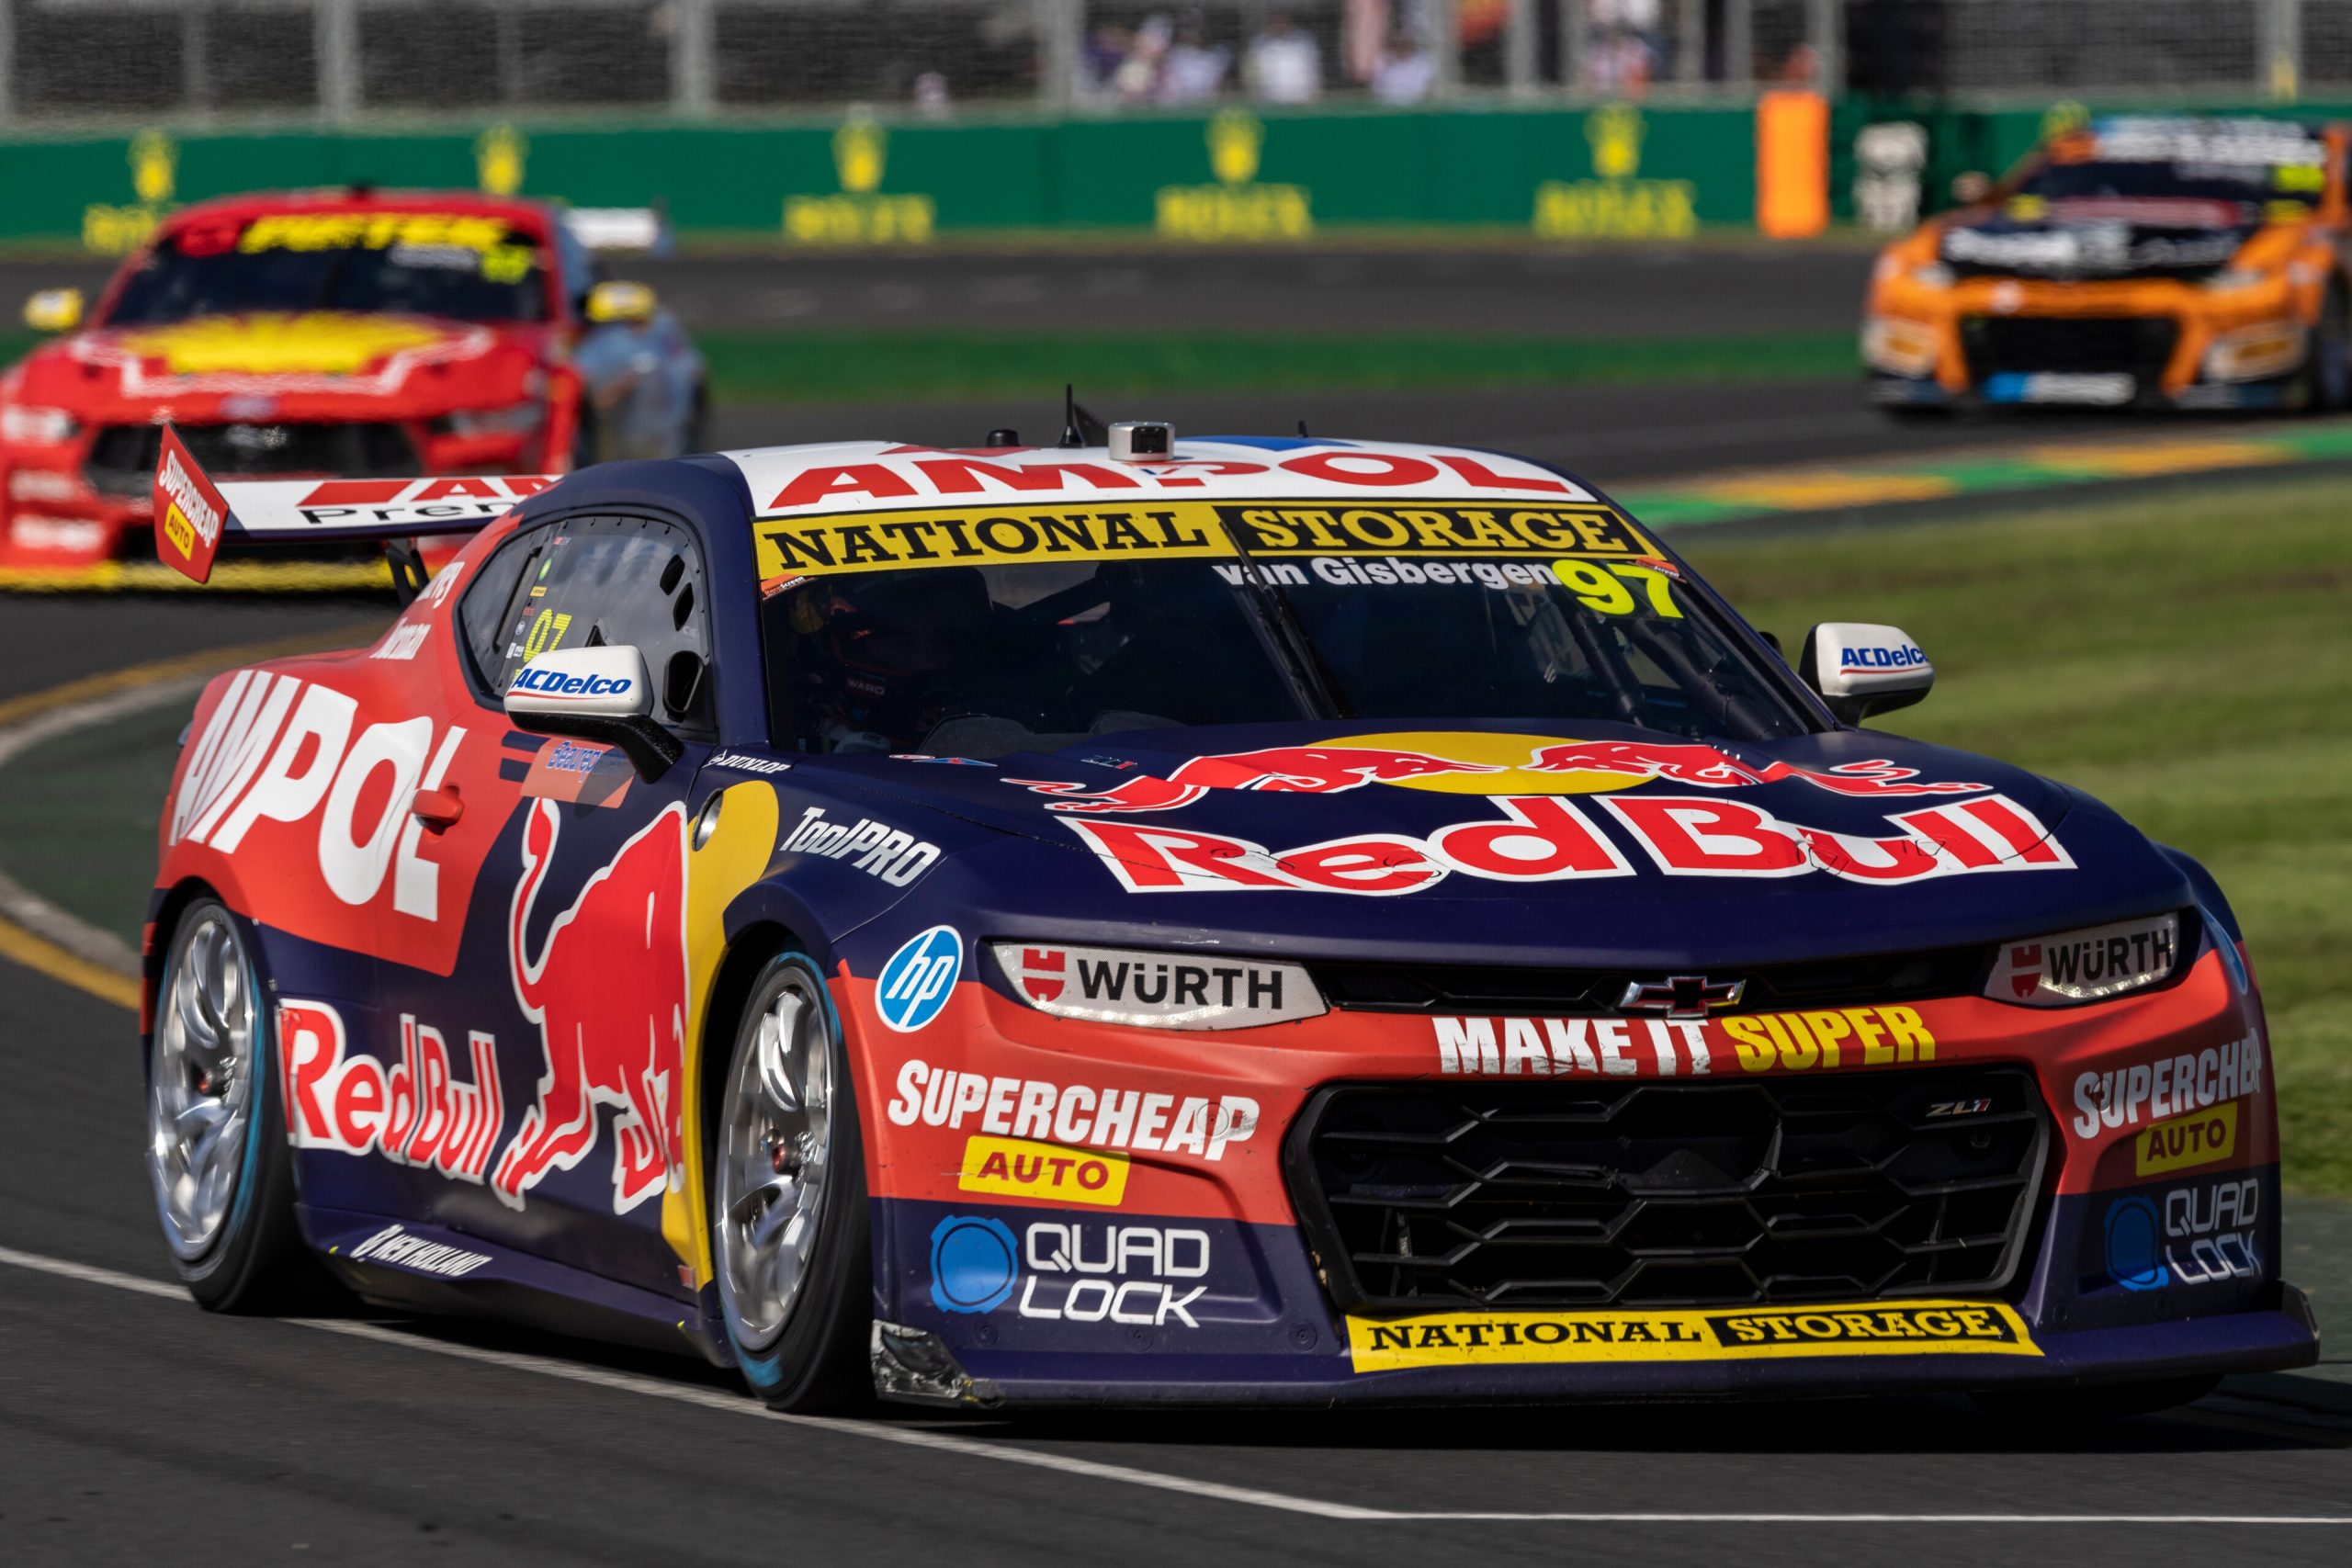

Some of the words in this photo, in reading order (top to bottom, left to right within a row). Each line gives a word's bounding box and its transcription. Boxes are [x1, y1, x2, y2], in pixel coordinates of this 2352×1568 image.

[159, 450, 219, 548] SUPERCHEAP
[770, 451, 1569, 511] AMPOL
[169, 514, 190, 549] AUTO
[763, 511, 1210, 570] NATIONAL
[1241, 509, 1632, 551] STORAGE
[1211, 563, 1310, 586] van
[1315, 558, 1563, 591] Gisbergen
[1551, 558, 1685, 619] 97
[511, 668, 631, 695] ACDelco
[717, 754, 791, 774] DUNLOP
[169, 670, 468, 922] AMPOL
[780, 807, 941, 887] ToolPRO
[1053, 795, 1637, 897] Red
[1590, 794, 2079, 886] Bull
[1078, 958, 1283, 1010] WÜRTH
[2049, 929, 2171, 986] WÜRTH
[1432, 1016, 1637, 1076] MAKE
[1645, 1017, 1713, 1076] IT
[1721, 1004, 1936, 1074] SUPER
[278, 998, 418, 1163] Red
[407, 1022, 505, 1185] Bull
[888, 1059, 1261, 1162] SUPERCHEAP
[2146, 1119, 2227, 1162] AUTO
[979, 1151, 1110, 1191] AUTO
[2165, 1178, 2259, 1237] QUAD
[1025, 1222, 1210, 1278] QUAD
[2165, 1230, 2262, 1285] LOCK
[1019, 1275, 1208, 1327] LOCK
[1371, 1319, 1704, 1351] NATIONAL
[1719, 1305, 2002, 1341] STORAGE
